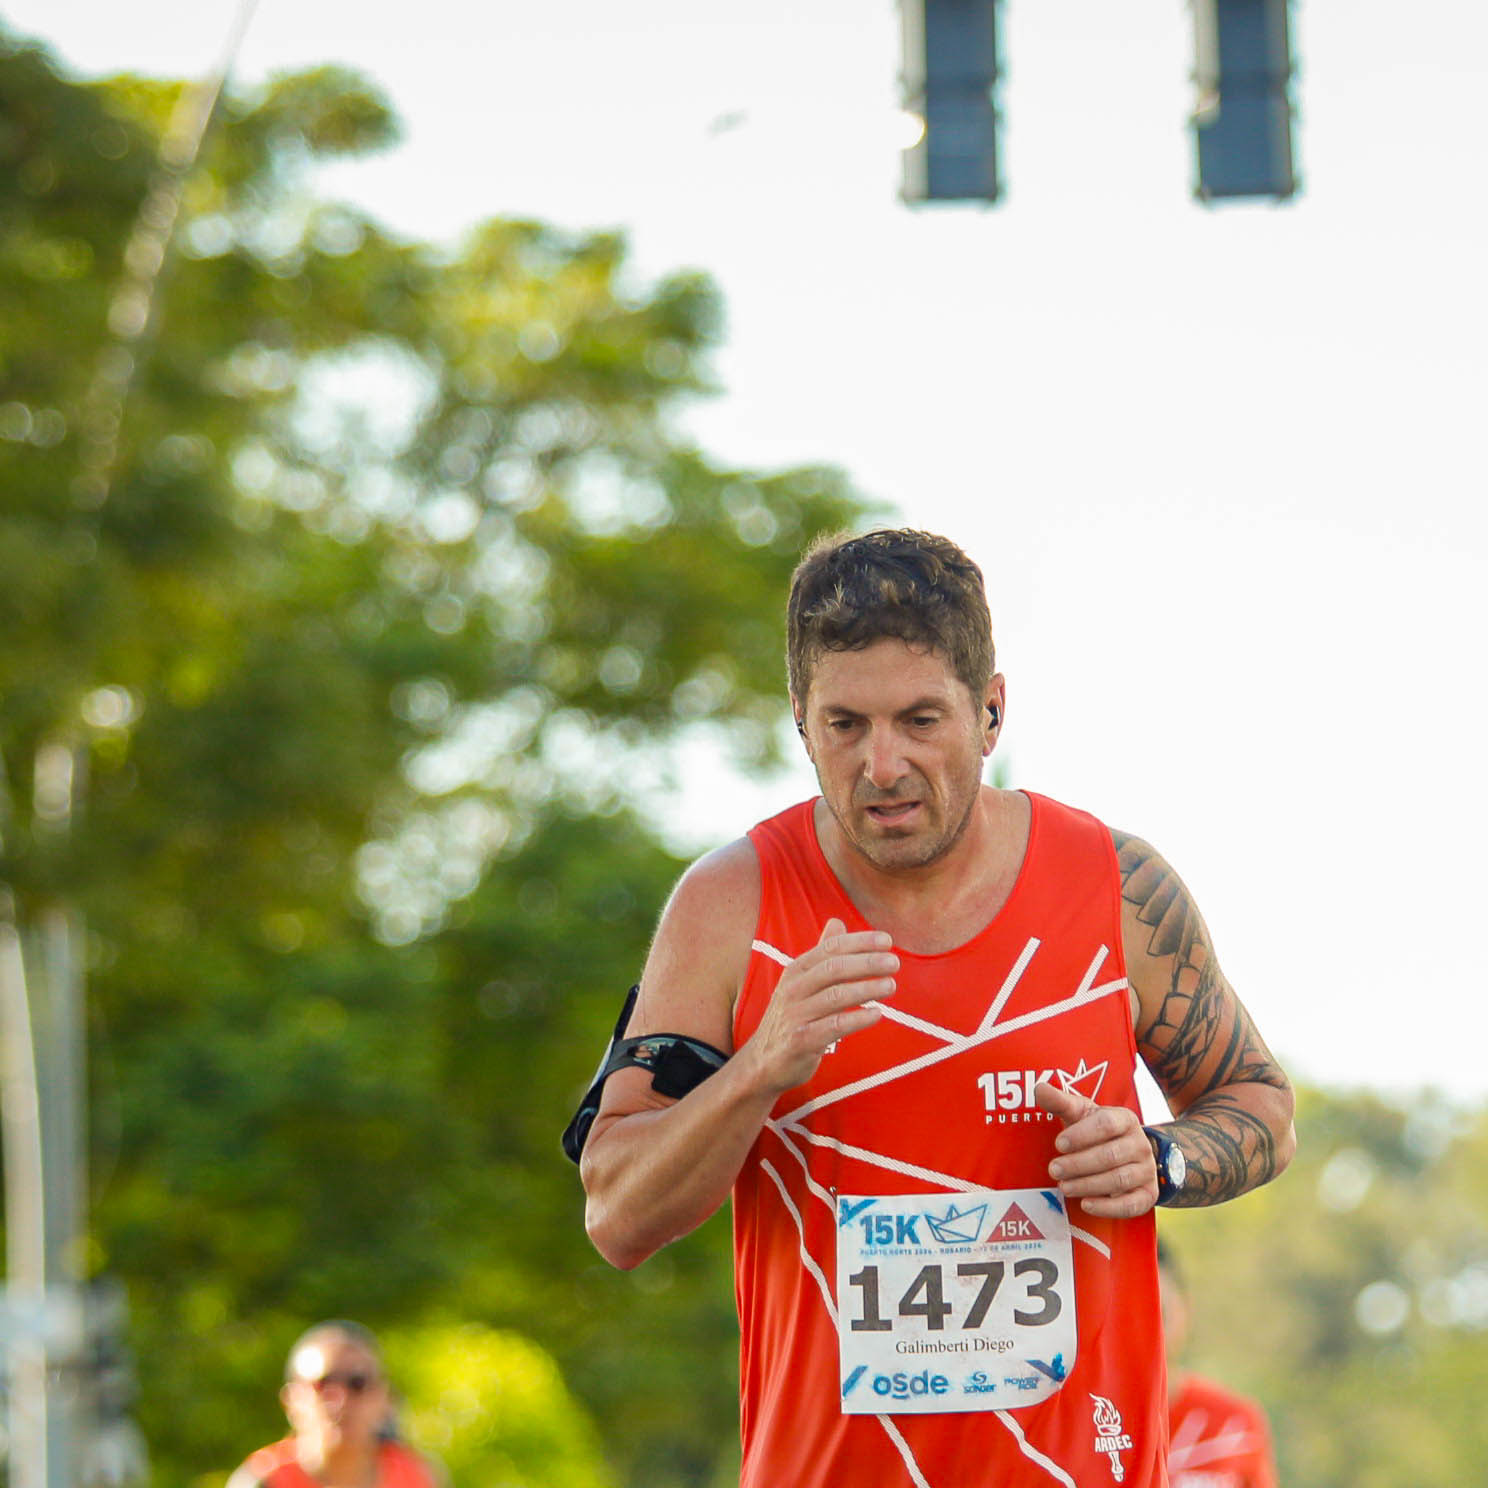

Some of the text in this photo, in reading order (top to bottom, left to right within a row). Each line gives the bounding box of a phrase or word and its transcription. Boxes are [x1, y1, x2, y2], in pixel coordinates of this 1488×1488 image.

[977, 1070, 1054, 1110] 15K
[986, 1112, 1054, 1125] PUERTO
[860, 1215, 921, 1245] 15K
[999, 1220, 1031, 1237] 15K
[849, 1258, 1063, 1332] 1473
[895, 1338, 1014, 1354] Galimberti Diego
[872, 1370, 949, 1398] osde
[1095, 1434, 1133, 1453] ARDEC
